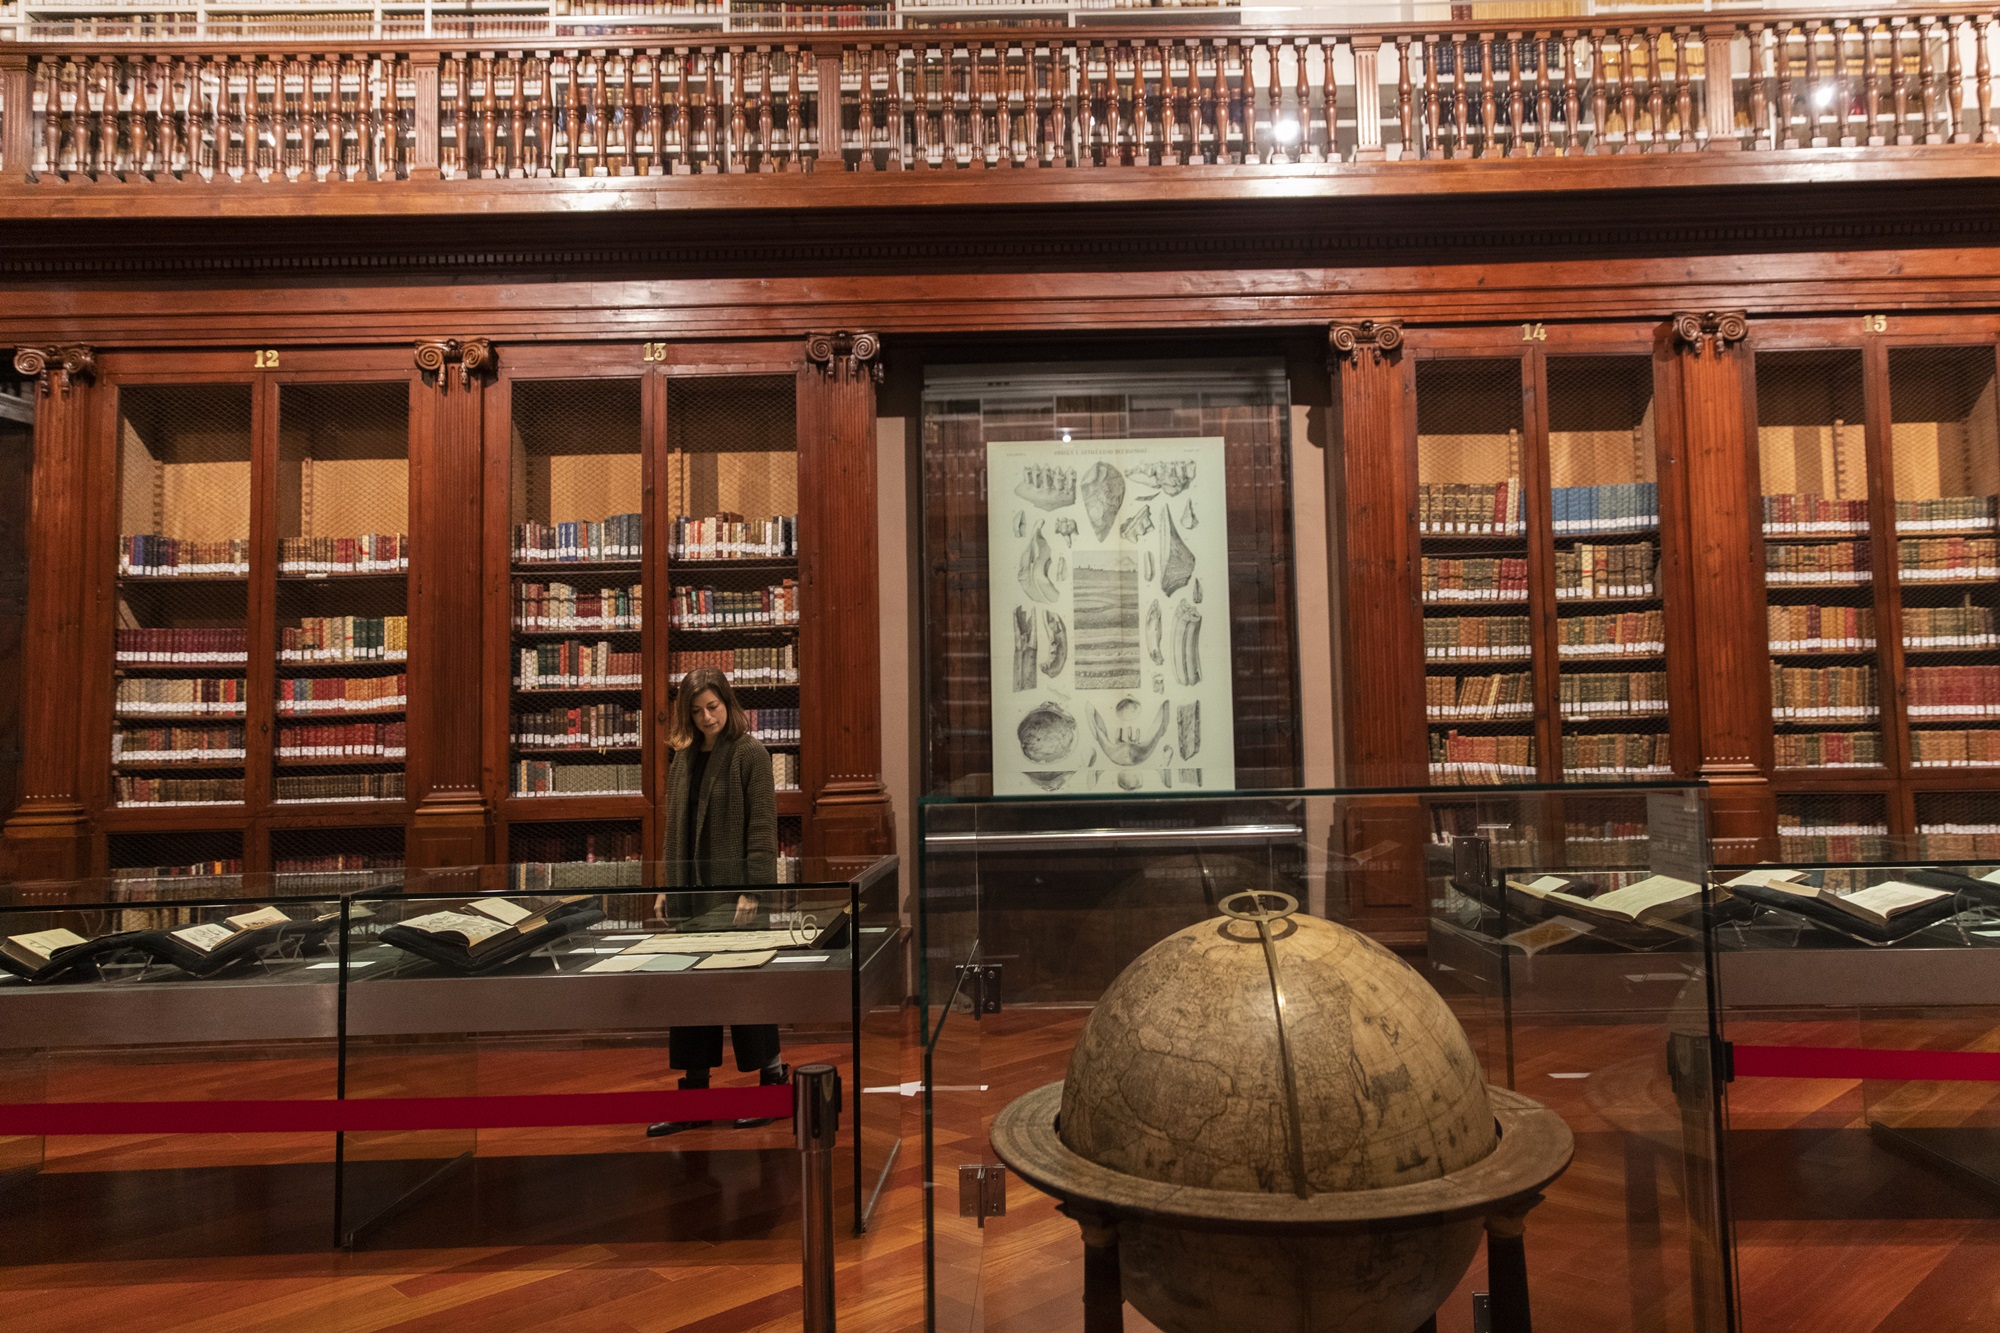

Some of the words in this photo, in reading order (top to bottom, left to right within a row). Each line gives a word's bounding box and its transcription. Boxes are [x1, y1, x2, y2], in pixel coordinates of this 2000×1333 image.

[1521, 322, 1547, 341] 14
[1862, 315, 1887, 333] 15
[254, 350, 279, 368] 12
[643, 342, 667, 361] 13
